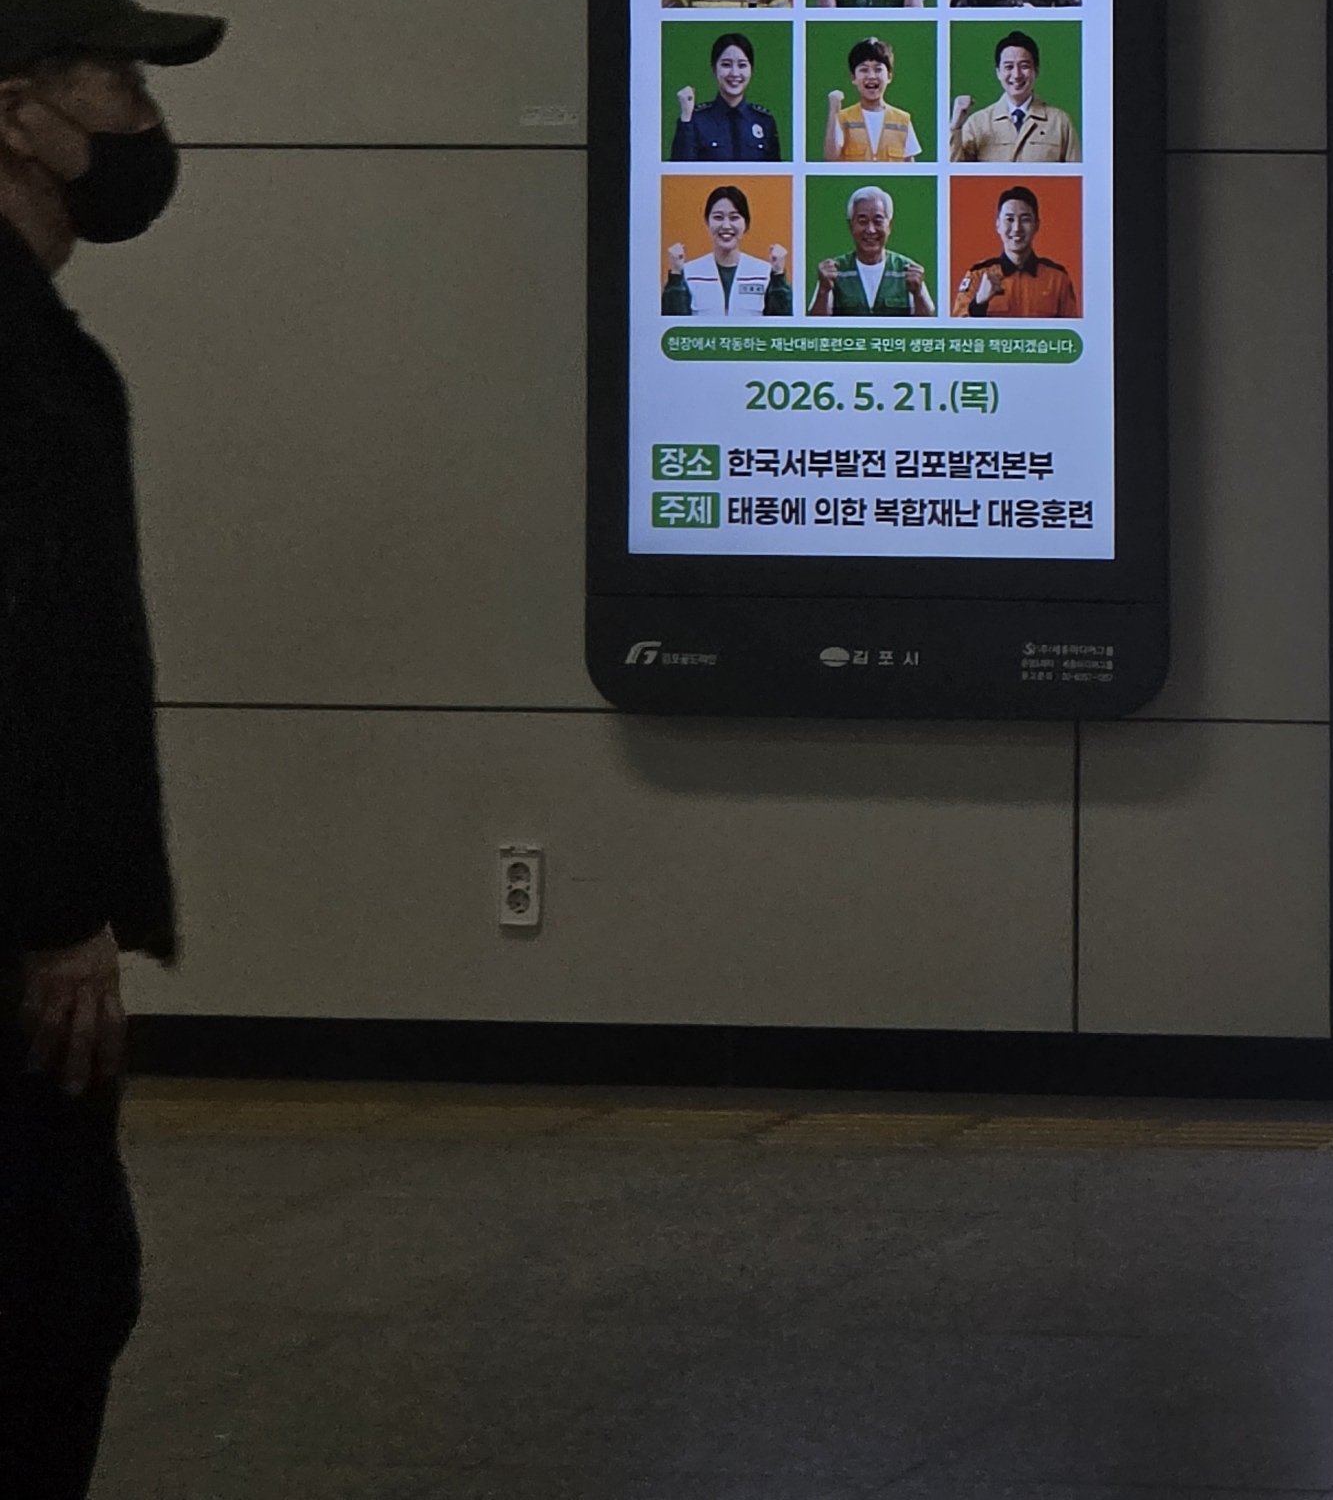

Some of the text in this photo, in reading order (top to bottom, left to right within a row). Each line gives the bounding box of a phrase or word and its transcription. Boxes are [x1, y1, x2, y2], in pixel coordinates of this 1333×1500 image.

[668, 336, 1077, 354] 현장에서 작동하는 재난대비훈련으로 국민의 생명과 재산을 책임지겠습니다.
[745, 381, 999, 414] 2026. 5. 21.(목)
[660, 448, 1054, 480] 장소 한국서부발전 김포발전본부
[659, 496, 1094, 529] 주제 태풍에 의한 복합재난 대응훈련
